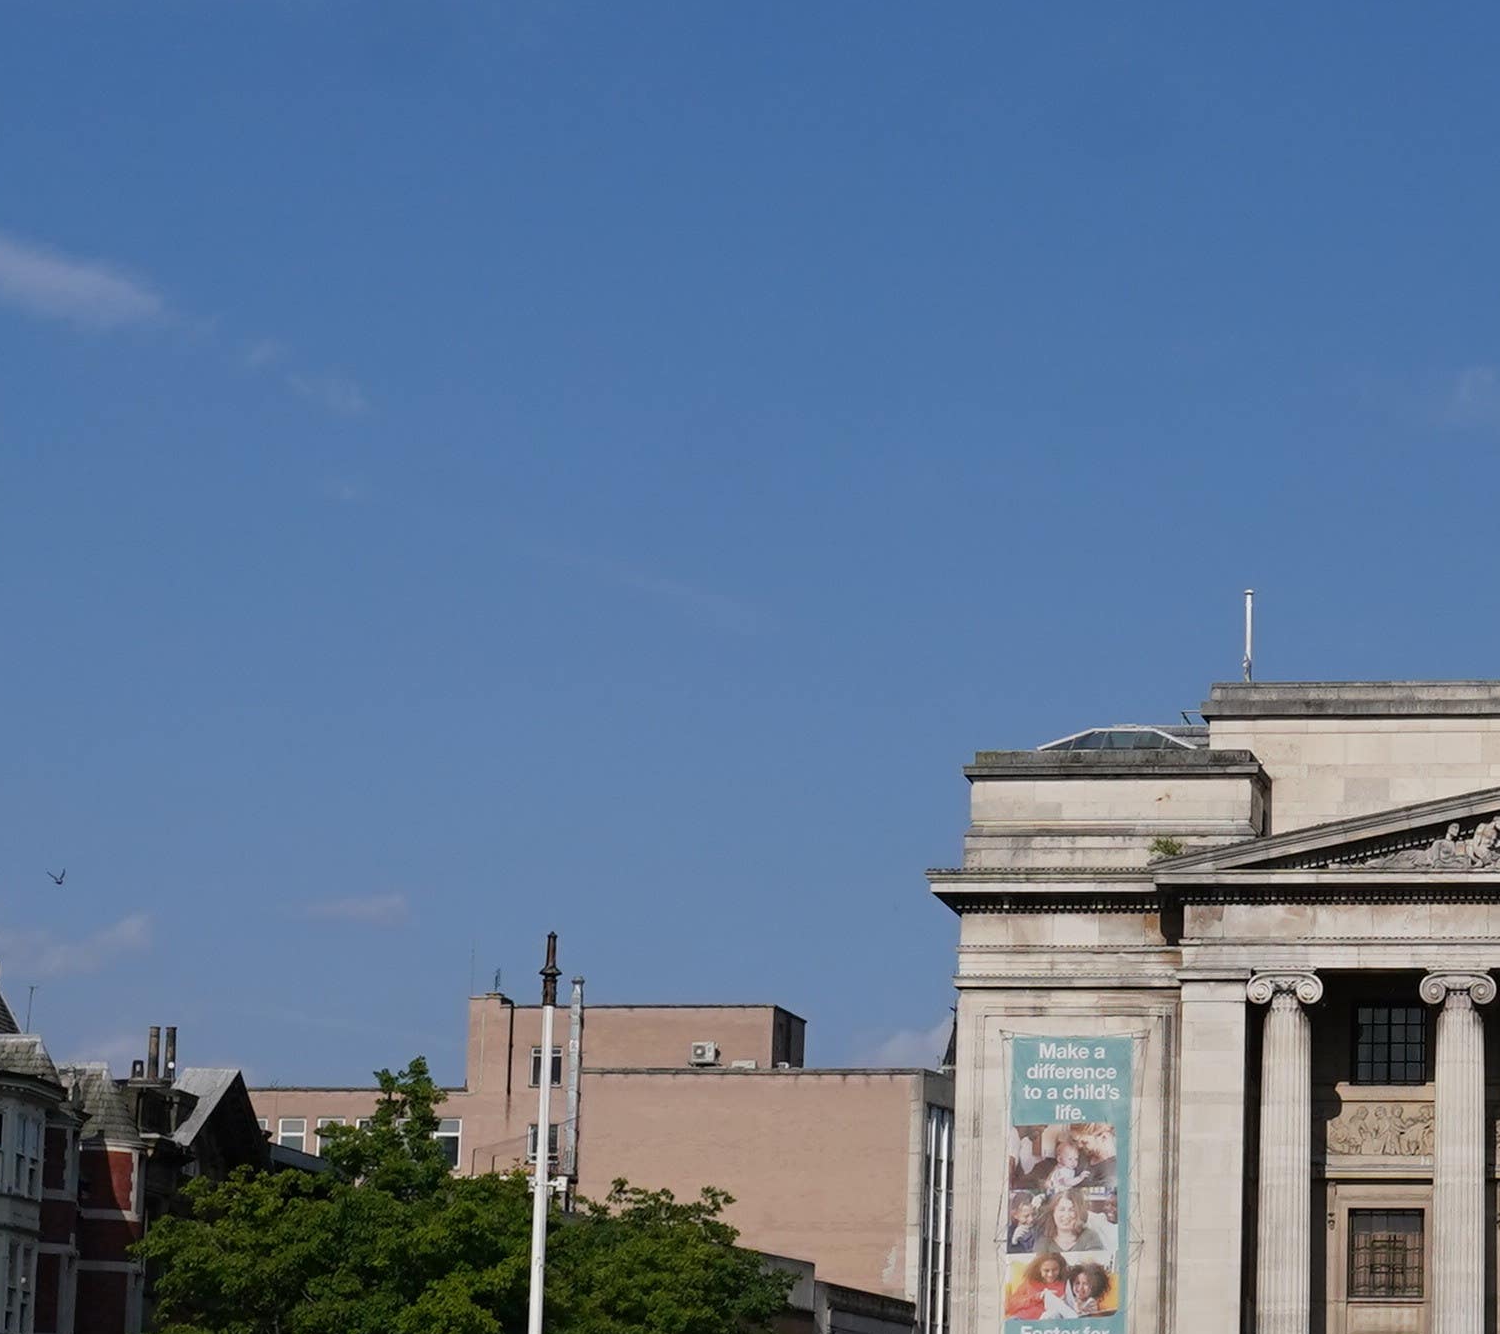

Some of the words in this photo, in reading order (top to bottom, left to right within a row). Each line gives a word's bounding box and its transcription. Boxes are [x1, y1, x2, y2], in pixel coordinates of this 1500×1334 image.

[1039, 1043, 1089, 1060] Make
[1094, 1046, 1105, 1060] a
[1027, 1064, 1117, 1080] difference
[1023, 1086, 1042, 1100] to
[1047, 1087, 1057, 1100] a
[1063, 1084, 1120, 1100] child's
[1055, 1104, 1086, 1121] life.
